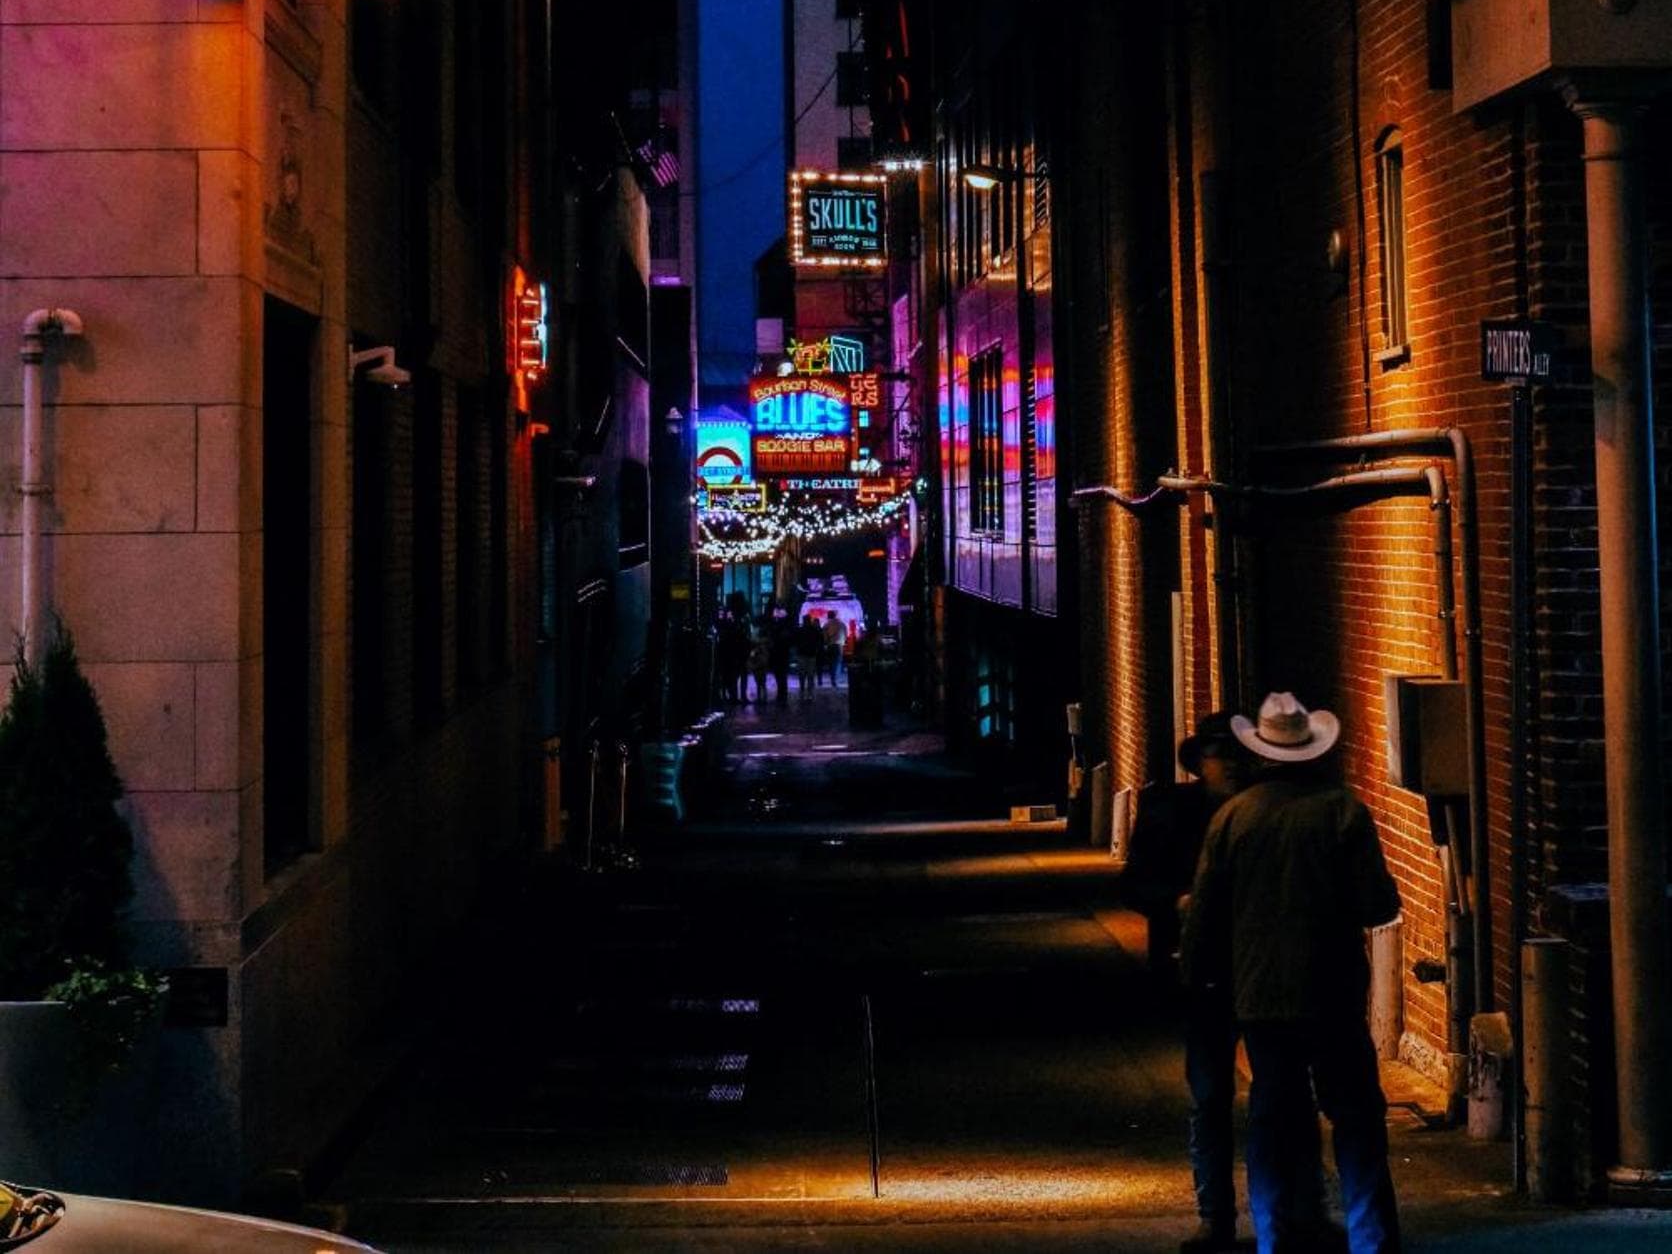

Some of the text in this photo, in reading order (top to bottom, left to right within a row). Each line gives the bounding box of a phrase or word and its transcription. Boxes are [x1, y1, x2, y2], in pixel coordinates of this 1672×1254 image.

[809, 197, 877, 232] SKULL'S
[1487, 329, 1530, 374] PRINTERS
[754, 379, 846, 399] Bourbon Street
[756, 391, 847, 432] BLUES
[756, 440, 846, 452] BOOGIE BAR
